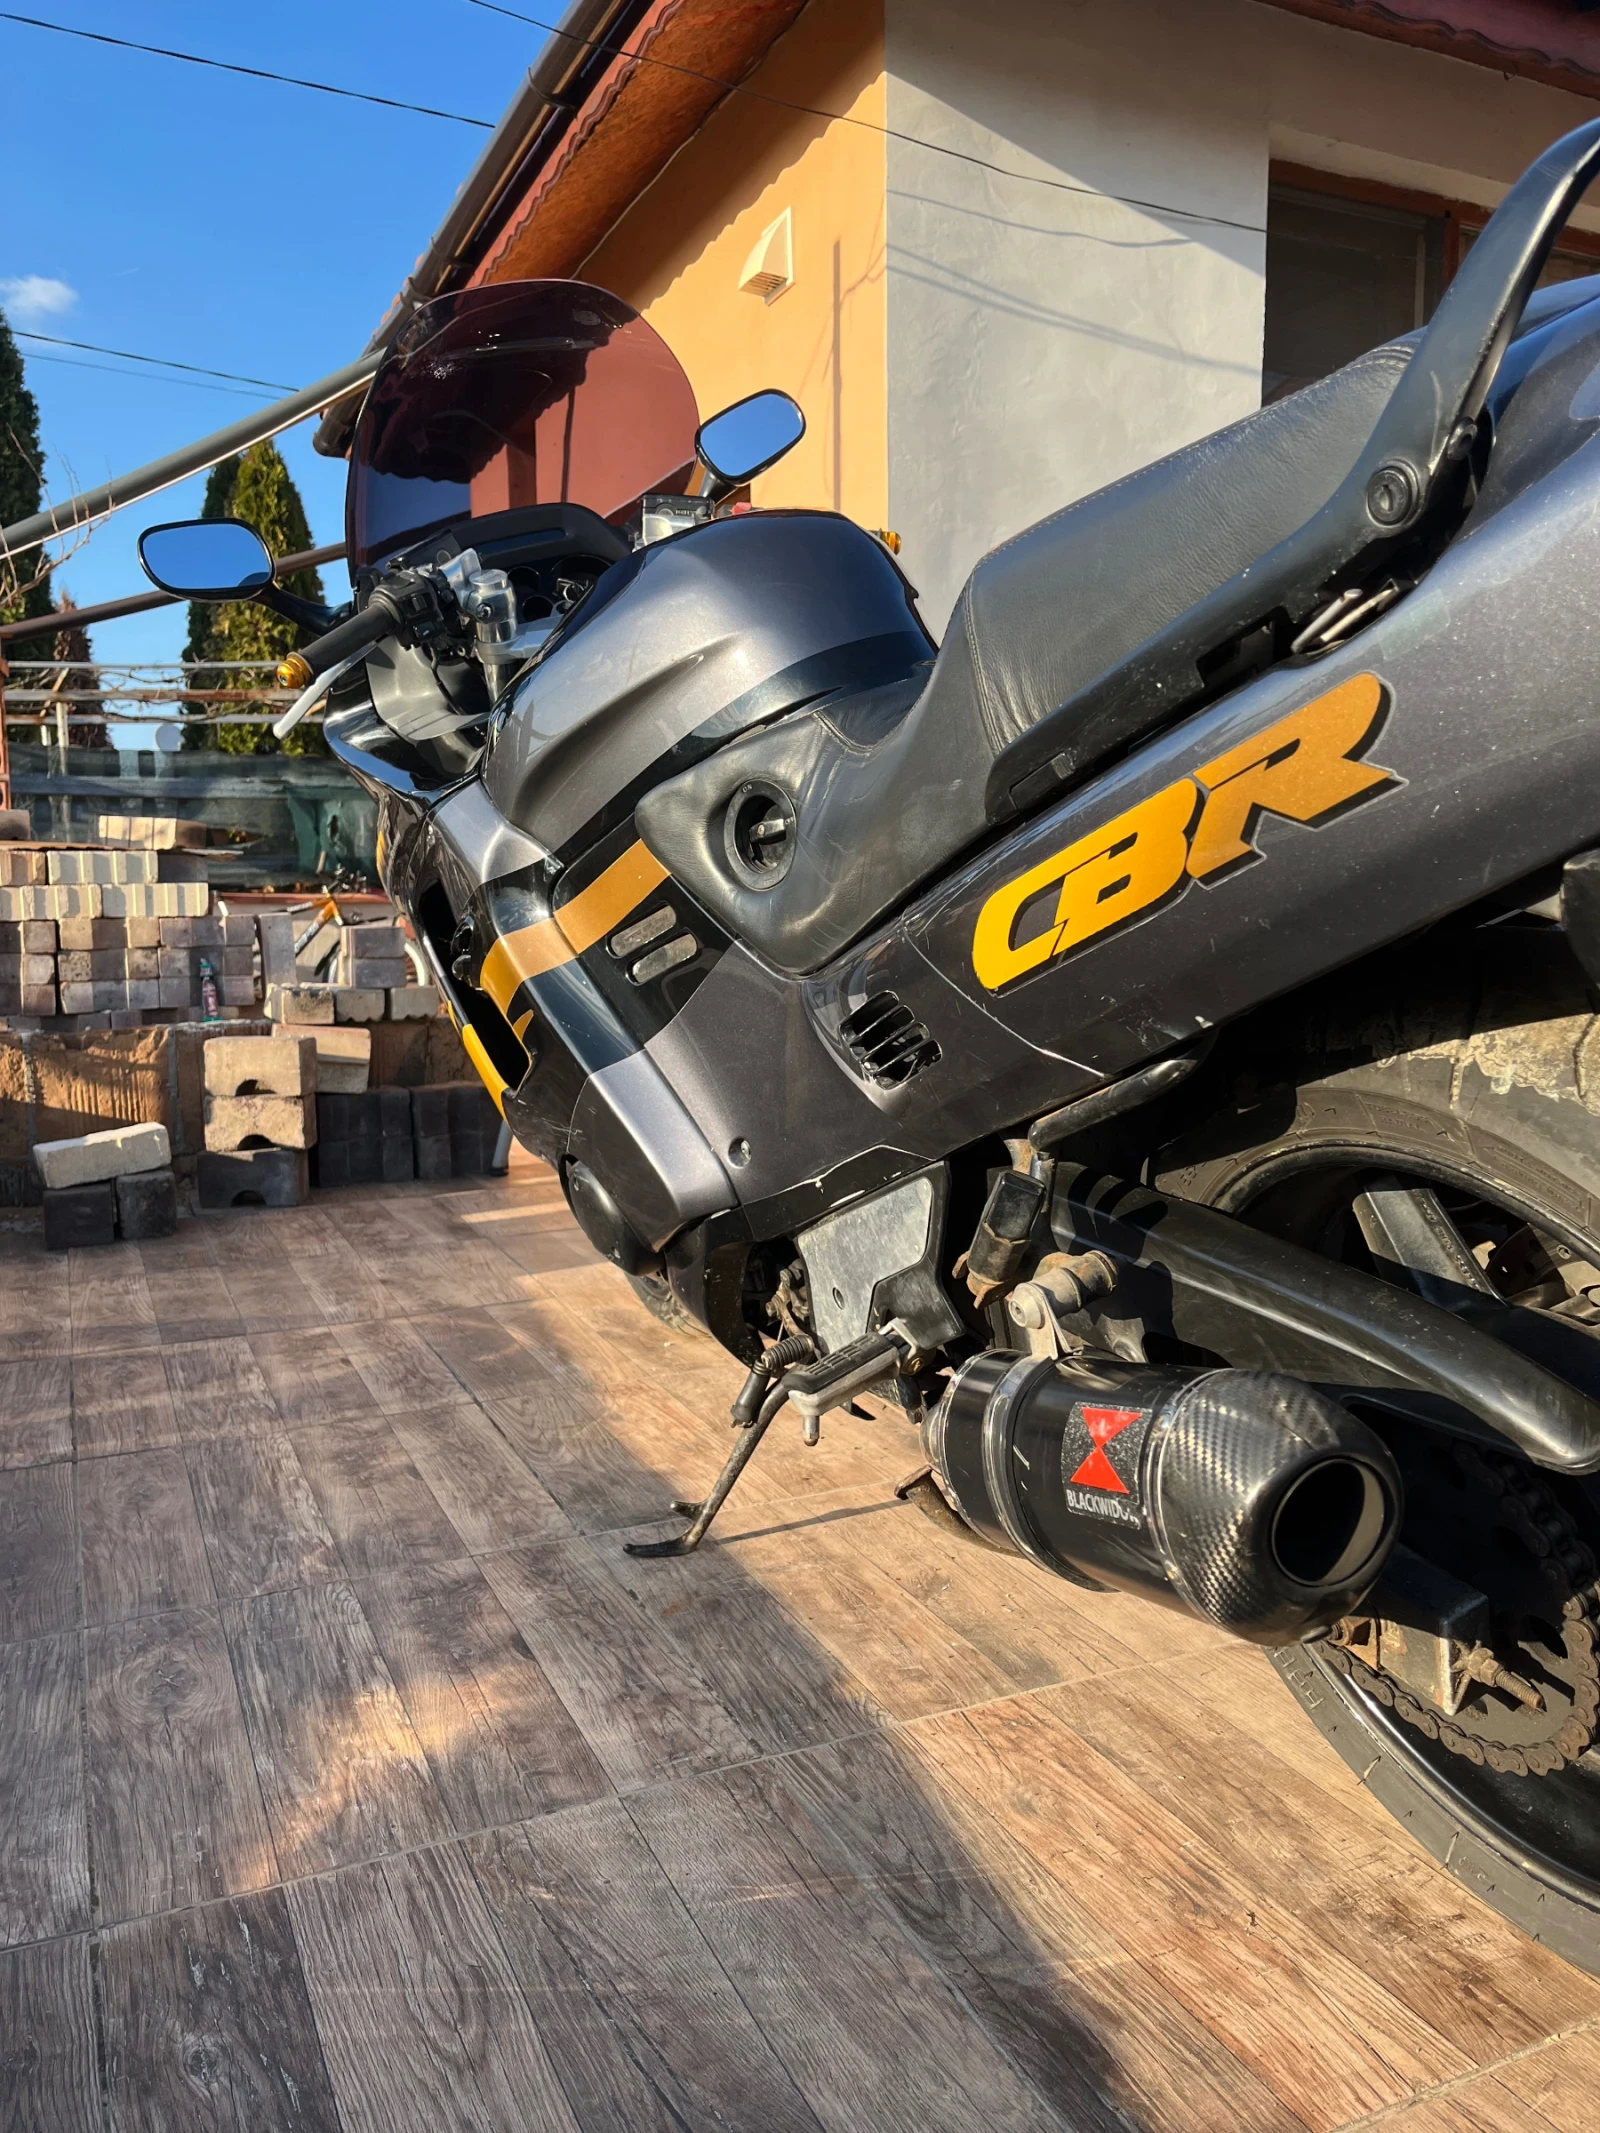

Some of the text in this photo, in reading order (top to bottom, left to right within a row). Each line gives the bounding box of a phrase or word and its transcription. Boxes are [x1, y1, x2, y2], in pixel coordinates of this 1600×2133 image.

[742, 784, 753, 793] ON
[972, 670, 1402, 994] CBR
[1066, 1489, 1140, 1525] BLACKWIDO
